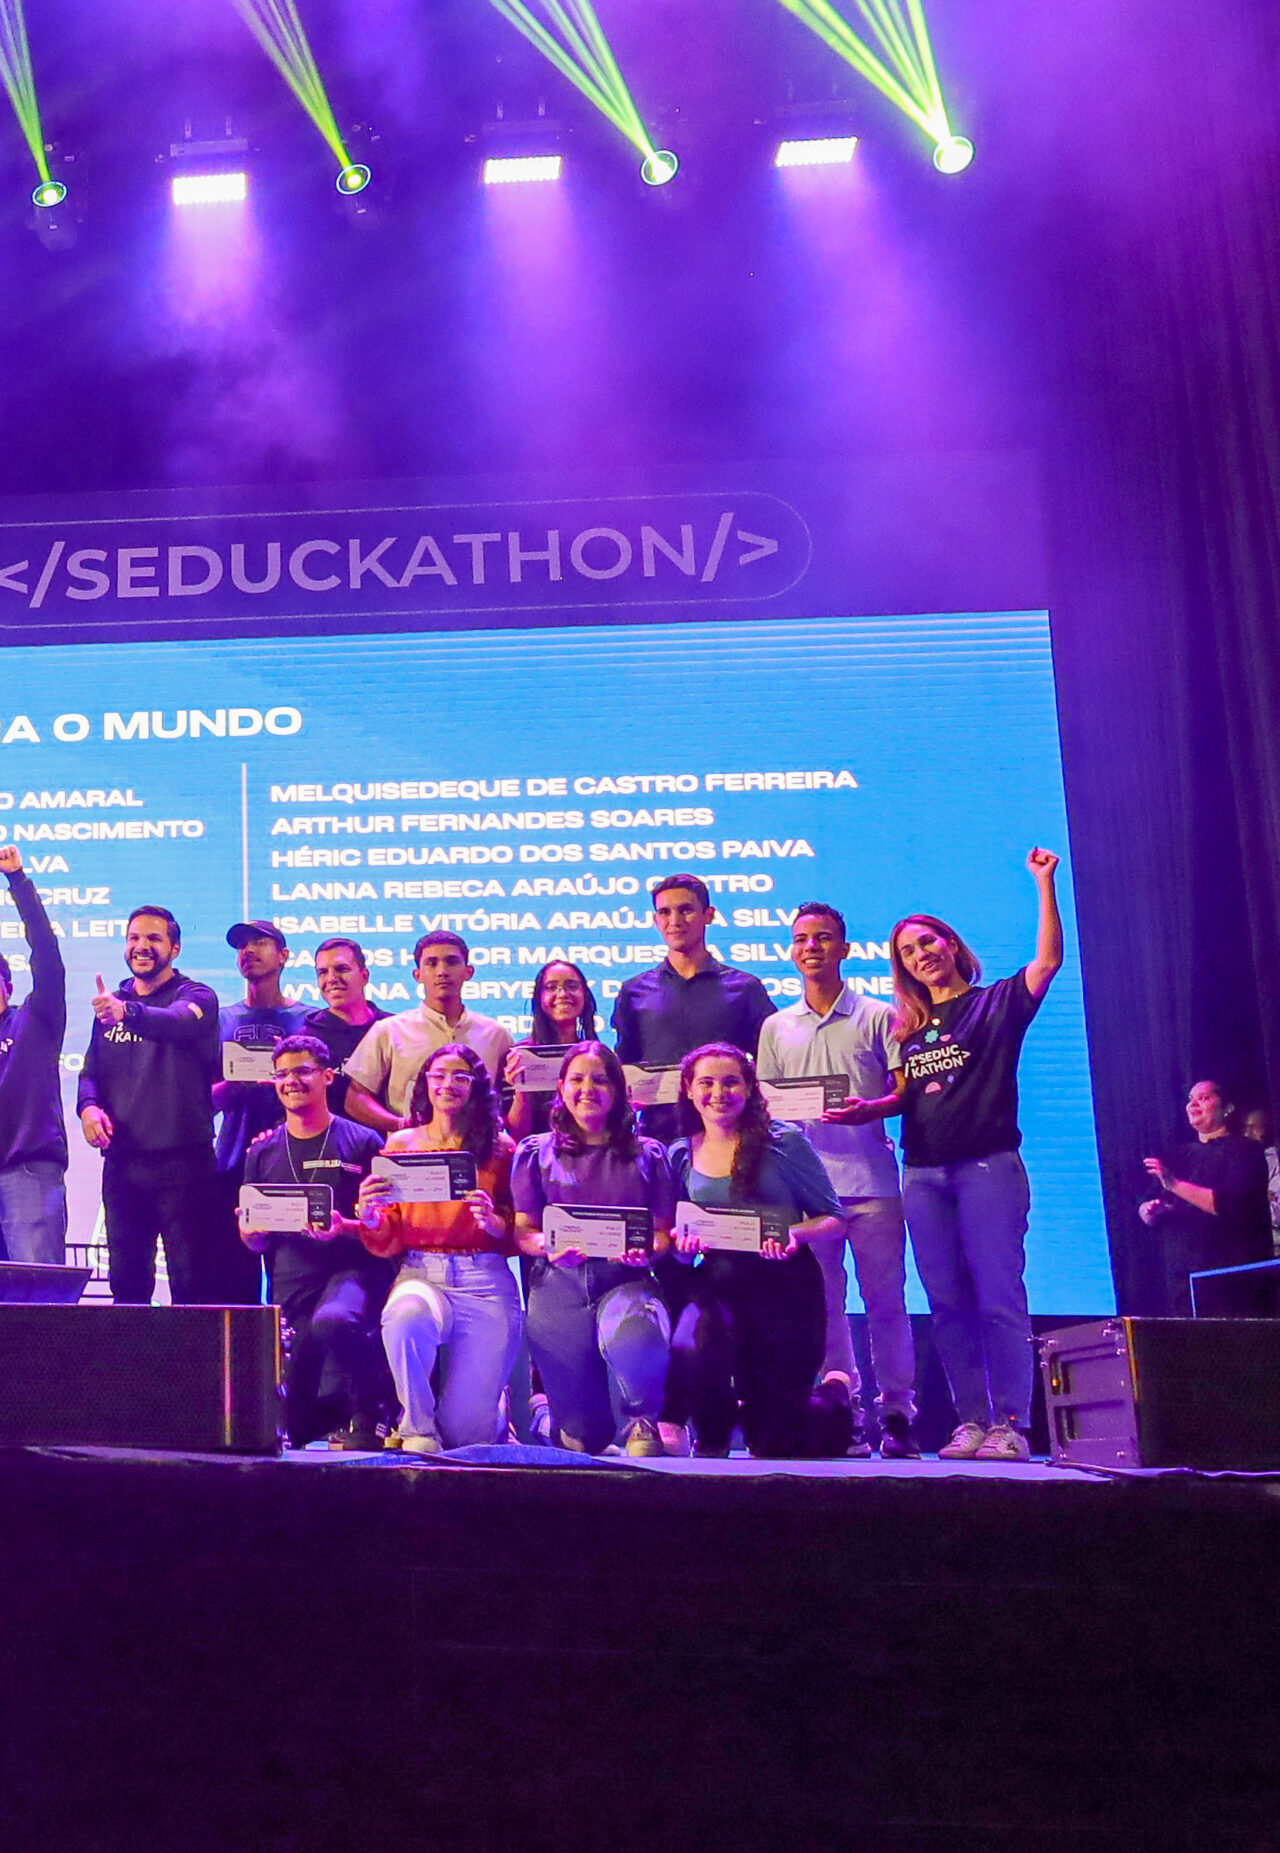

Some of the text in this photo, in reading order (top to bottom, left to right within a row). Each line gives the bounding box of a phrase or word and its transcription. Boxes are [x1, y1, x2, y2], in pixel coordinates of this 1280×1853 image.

[52, 712, 91, 743] O
[102, 706, 303, 741] MUNDO
[19, 789, 144, 810] AMARAL
[270, 770, 859, 804] MELQUISEDEQUE DE CASTRO FERREIRA
[13, 819, 205, 842] NASCIMENTO
[270, 807, 715, 835] ARTHUR FERNANDES SOARES
[271, 838, 816, 868] HÉRIC EDUARDO DOS SANTOS PAIVA
[36, 886, 111, 905] CRUZ
[272, 881, 379, 901] LANNA
[383, 879, 507, 899] REBECA
[511, 872, 640, 897] ARAÚJO
[72, 919, 128, 938] LEIT
[272, 913, 414, 934] ISABELLE
[419, 907, 543, 933] VITÓRIA
[547, 905, 656, 931] ARAÚJ
[733, 907, 798, 928] SILV
[518, 944, 670, 967] MARQUES
[730, 942, 794, 963] SILV
